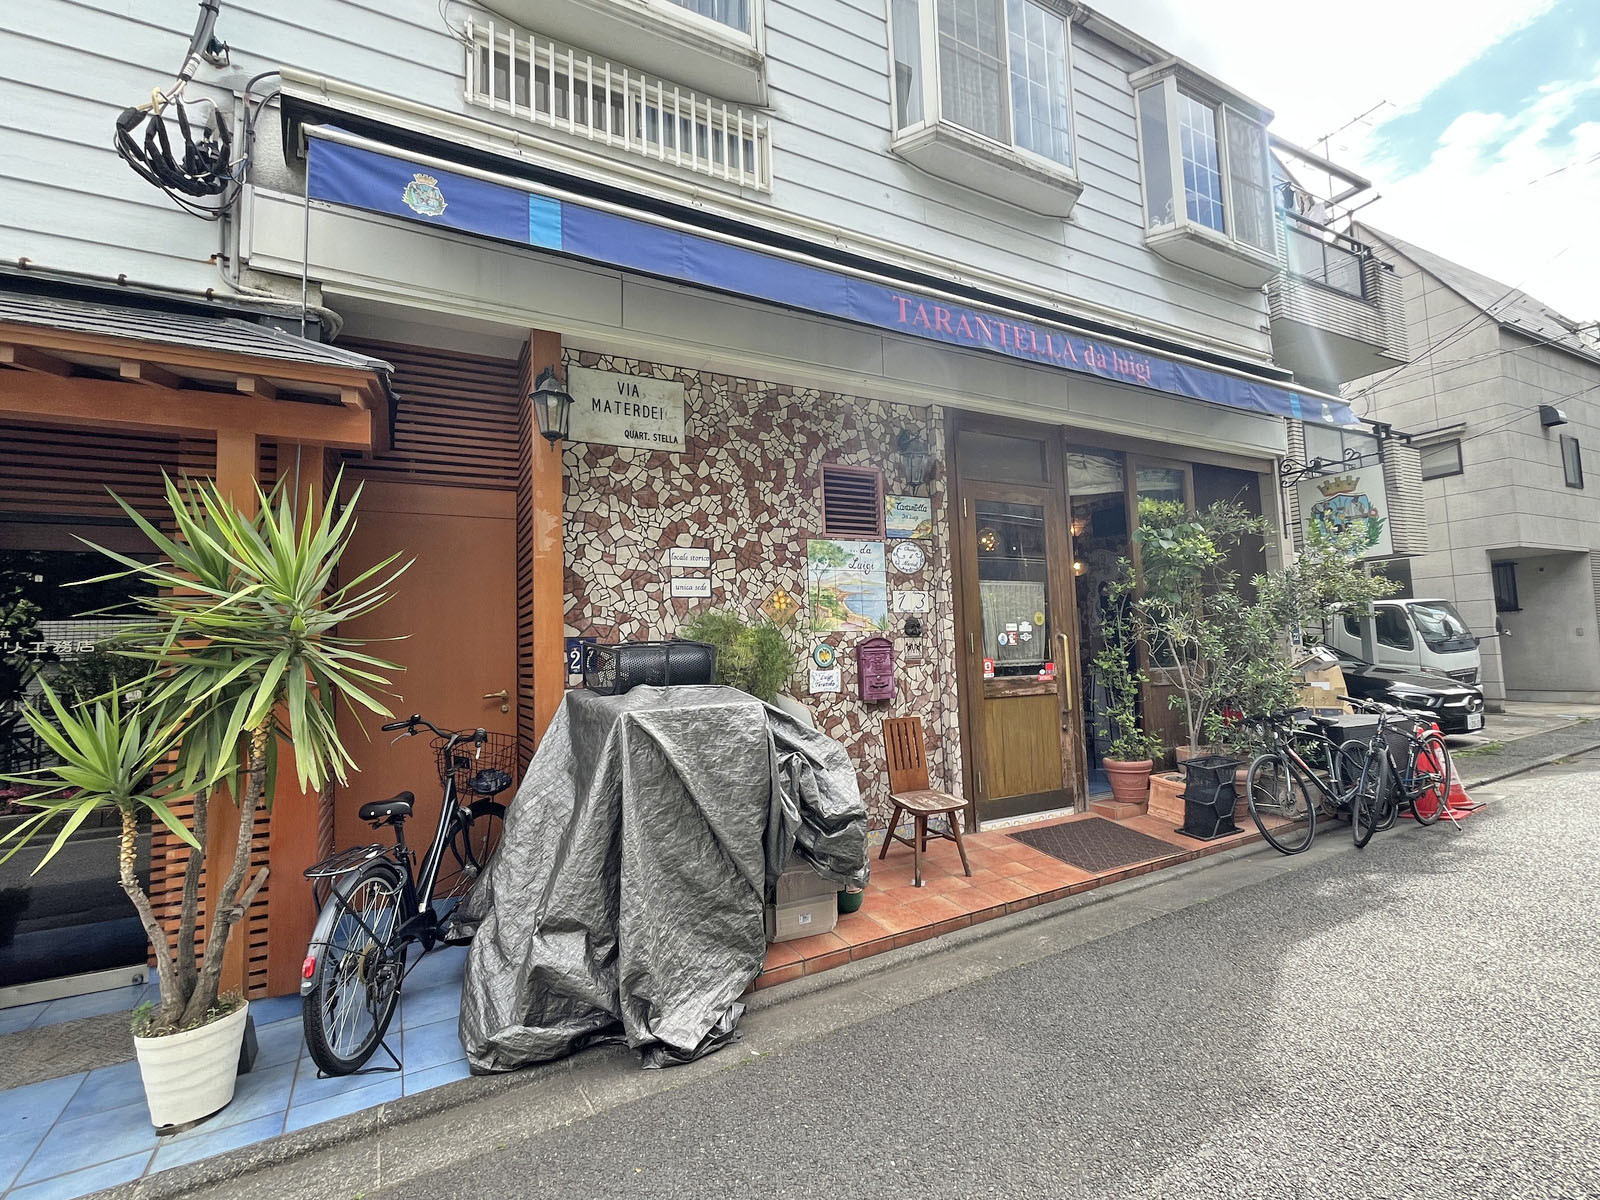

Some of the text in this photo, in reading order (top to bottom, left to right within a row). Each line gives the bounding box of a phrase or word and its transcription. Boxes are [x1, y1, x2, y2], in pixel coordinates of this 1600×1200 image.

[892, 295, 1151, 384] TARANTELLA da luigi
[617, 381, 639, 398] VIA
[592, 397, 663, 420] MATERDEI
[624, 430, 679, 444] QUART. STELLA
[690, 553, 710, 562] storico
[848, 557, 875, 575] Luigi
[695, 583, 707, 591] sede
[0, 640, 95, 654] リ工務店
